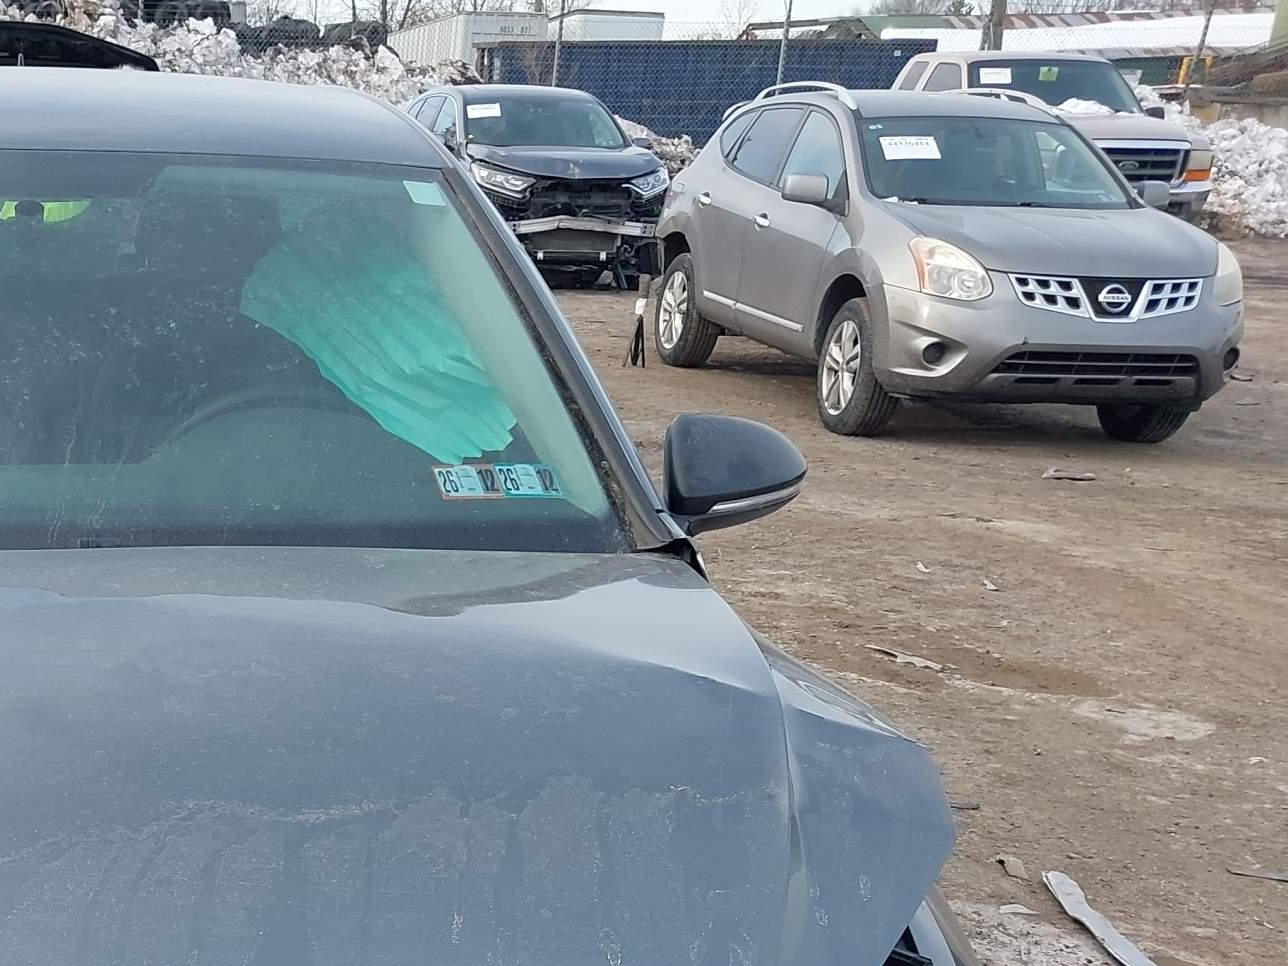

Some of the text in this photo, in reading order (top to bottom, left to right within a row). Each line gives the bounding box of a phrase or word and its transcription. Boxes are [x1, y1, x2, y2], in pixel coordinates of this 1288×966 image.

[438, 470, 459, 493] 26
[477, 469, 500, 492] 12
[498, 468, 520, 491] 26
[536, 468, 559, 492] 12
